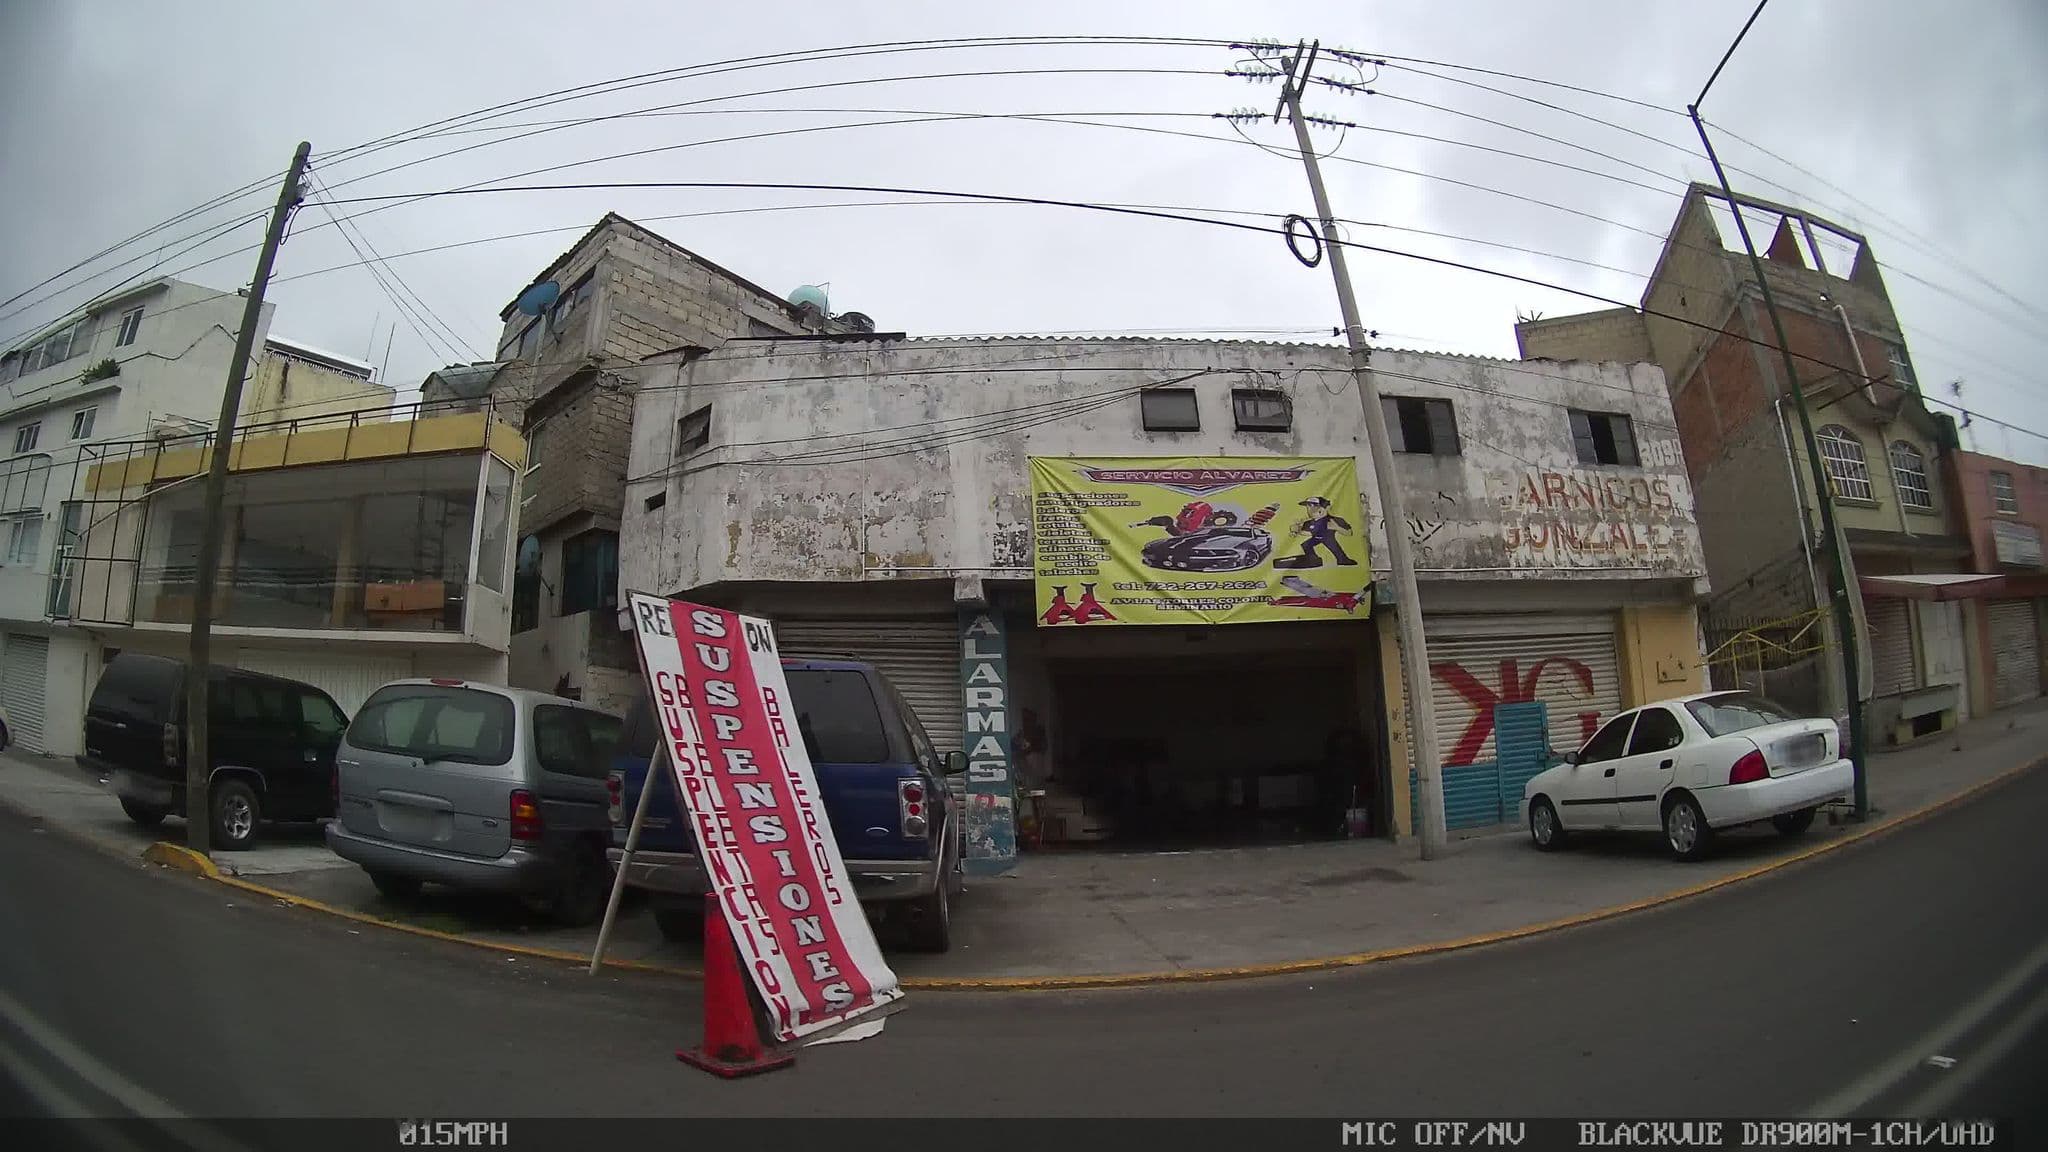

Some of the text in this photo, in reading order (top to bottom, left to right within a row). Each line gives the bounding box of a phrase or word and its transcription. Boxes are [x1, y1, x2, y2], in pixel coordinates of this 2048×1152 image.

[1100, 470, 1293, 480] SERVICIO ALVAREZ
[1499, 471, 1673, 513] ARNICOS
[1038, 537, 1111, 545] terminales
[1156, 603, 1233, 611] SEMINARIO
[964, 614, 1008, 783] ALARMAS
[691, 608, 854, 1016] SUSPENSIONES
[763, 686, 842, 905] BALEROS
